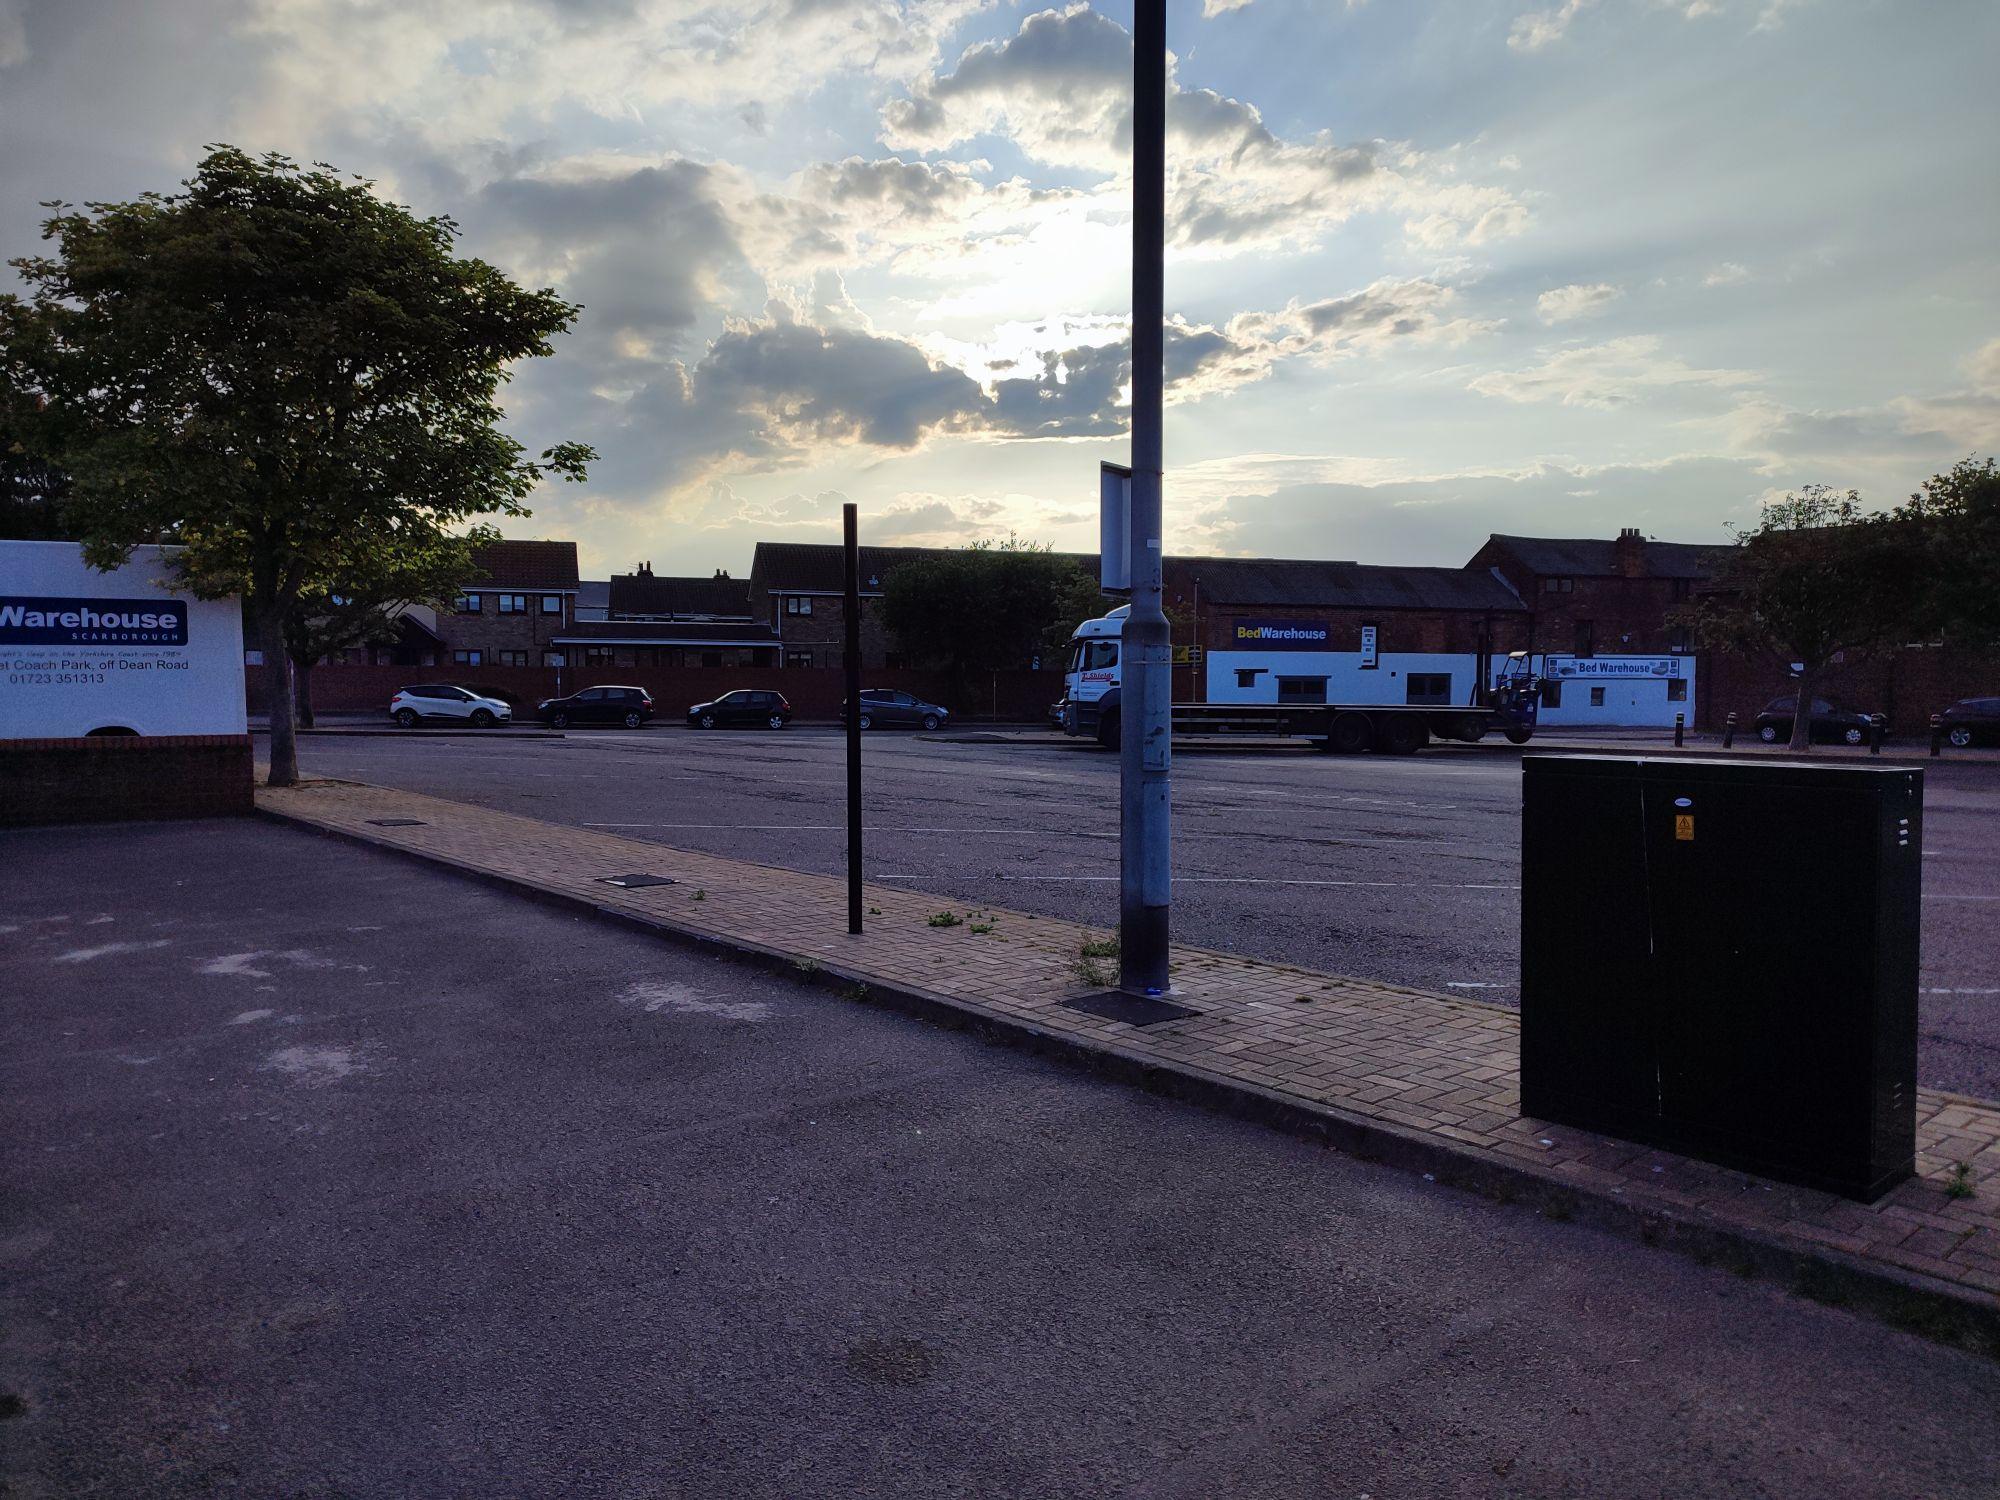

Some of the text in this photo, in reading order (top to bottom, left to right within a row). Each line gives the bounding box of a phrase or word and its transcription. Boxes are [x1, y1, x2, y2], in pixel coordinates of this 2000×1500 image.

[0, 606, 178, 629] Warehouse
[71, 632, 178, 641] SCARBOROUGH
[1237, 626, 1327, 639] BedWarehouse
[14, 660, 57, 670] Coach
[62, 660, 94, 672] Park,
[99, 660, 115, 670] off
[119, 660, 152, 670] Dean
[157, 660, 189, 670] Road
[1579, 662, 1597, 673] Bed
[1600, 662, 1650, 673] Warehouse
[9, 673, 104, 684] 01723 351313
